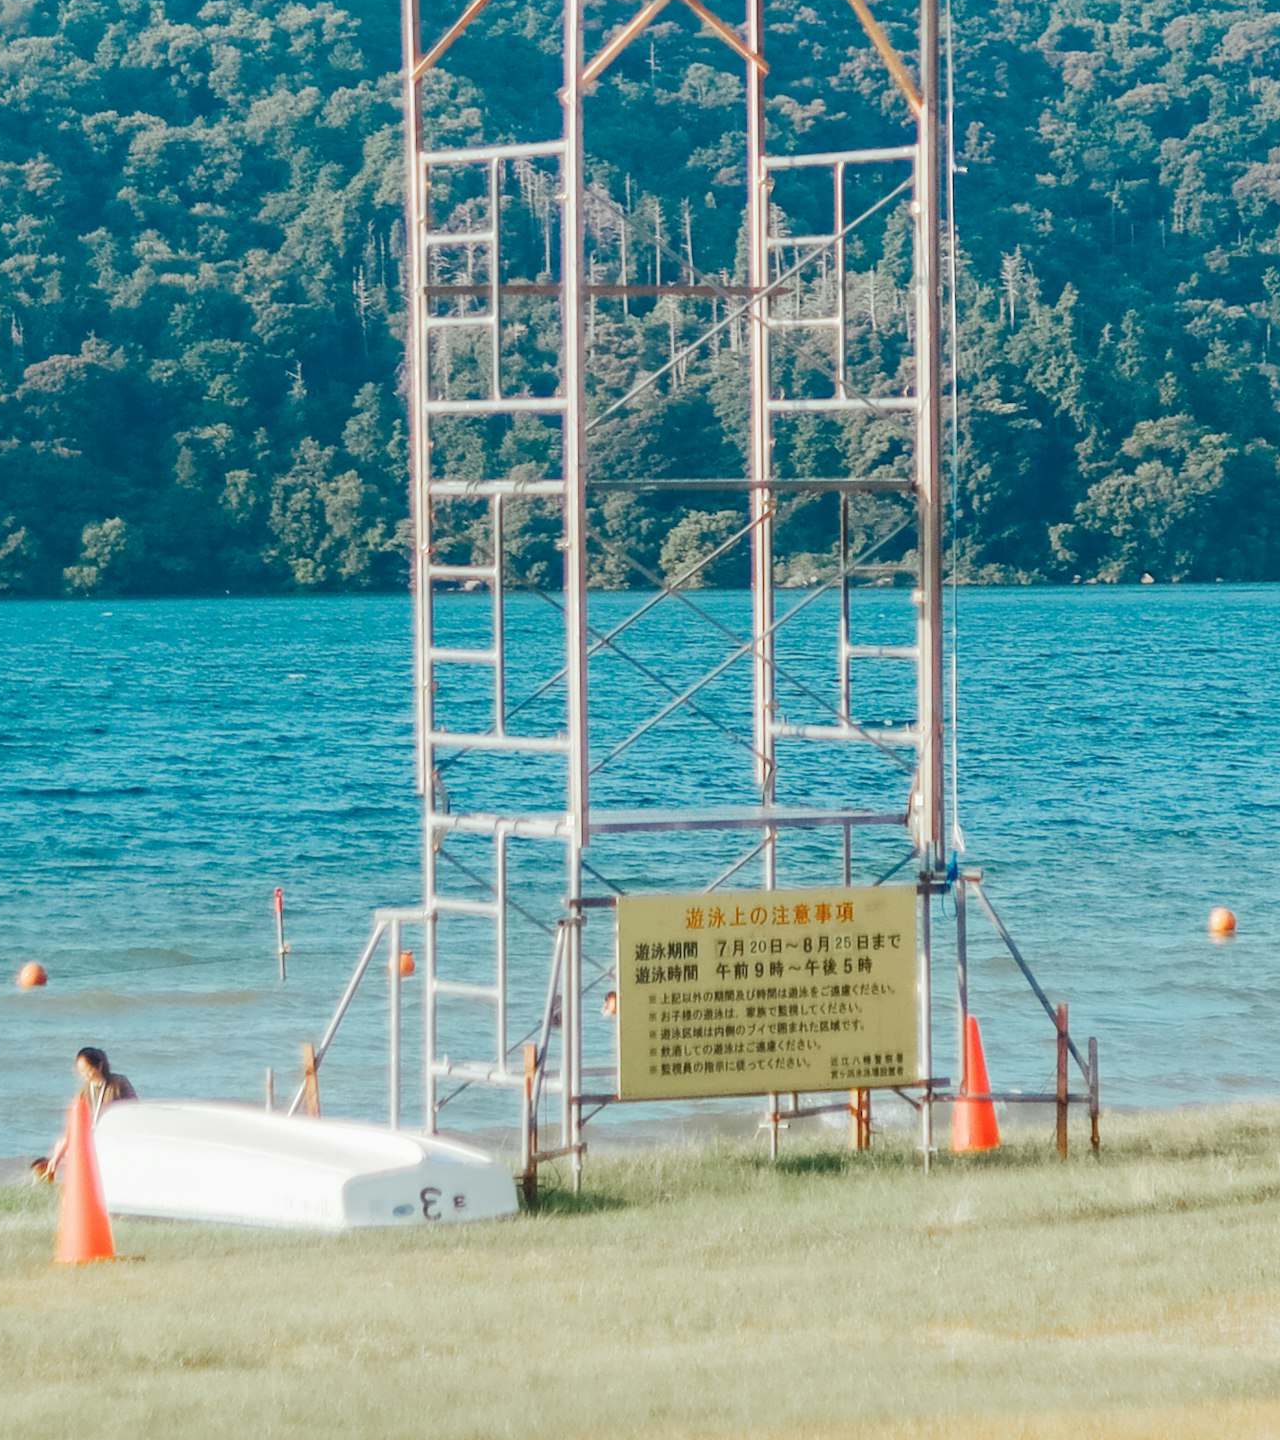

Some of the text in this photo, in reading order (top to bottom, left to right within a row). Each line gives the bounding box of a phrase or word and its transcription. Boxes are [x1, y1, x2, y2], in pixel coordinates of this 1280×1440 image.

[686, 902, 854, 929] 遊泳上の注意事項
[635, 941, 698, 961] 遊泳期間
[635, 963, 699, 984] 遊泳時間
